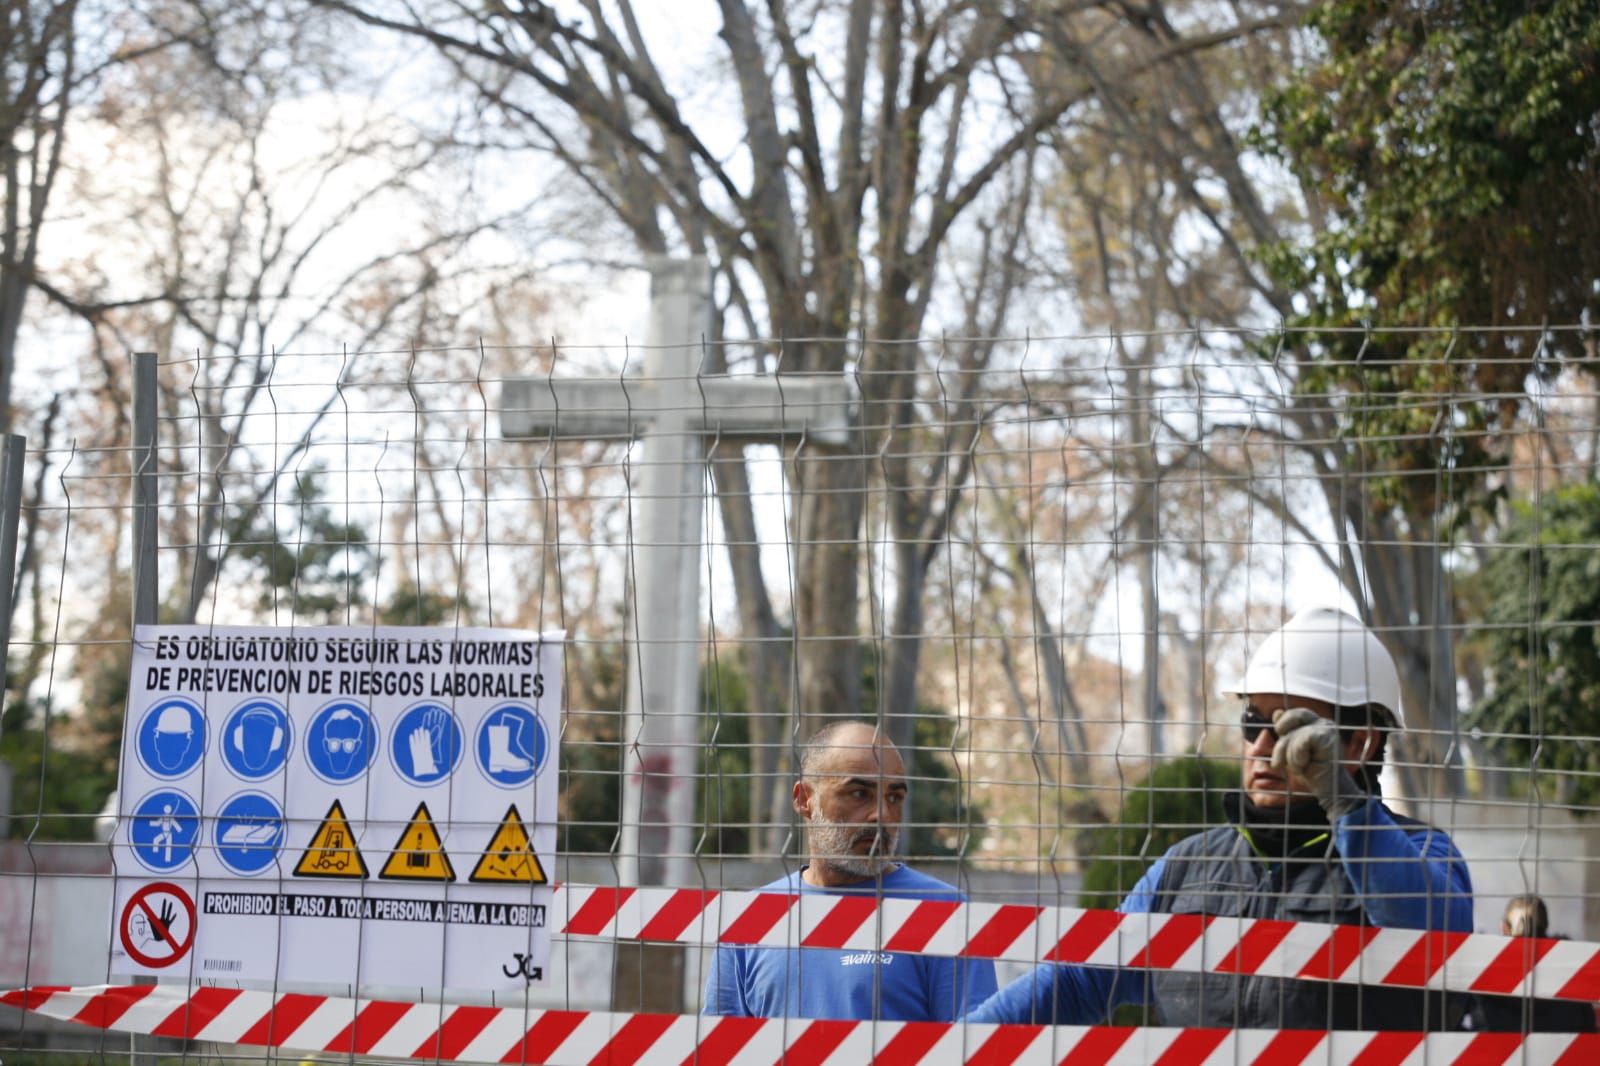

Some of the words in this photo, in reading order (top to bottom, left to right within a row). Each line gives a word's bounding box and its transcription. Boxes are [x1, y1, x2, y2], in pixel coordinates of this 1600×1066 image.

[156, 636, 180, 660] ES
[186, 636, 318, 663] OBLIGATORIO
[325, 638, 399, 664] SEGUIR
[406, 639, 443, 665] LAS
[449, 640, 533, 666] NORMAS
[146, 667, 171, 691] DE
[177, 668, 301, 693] PREVENCION
[308, 670, 332, 695] DE
[339, 671, 424, 697] RIESGOS
[430, 672, 544, 698] LABORALES
[206, 894, 273, 914] PROHIBIDO
[294, 896, 326, 916] PASO
[328, 898, 337, 917] A
[375, 900, 432, 921] PERSONA
[478, 904, 488, 924] A
[490, 904, 507, 925] LA
